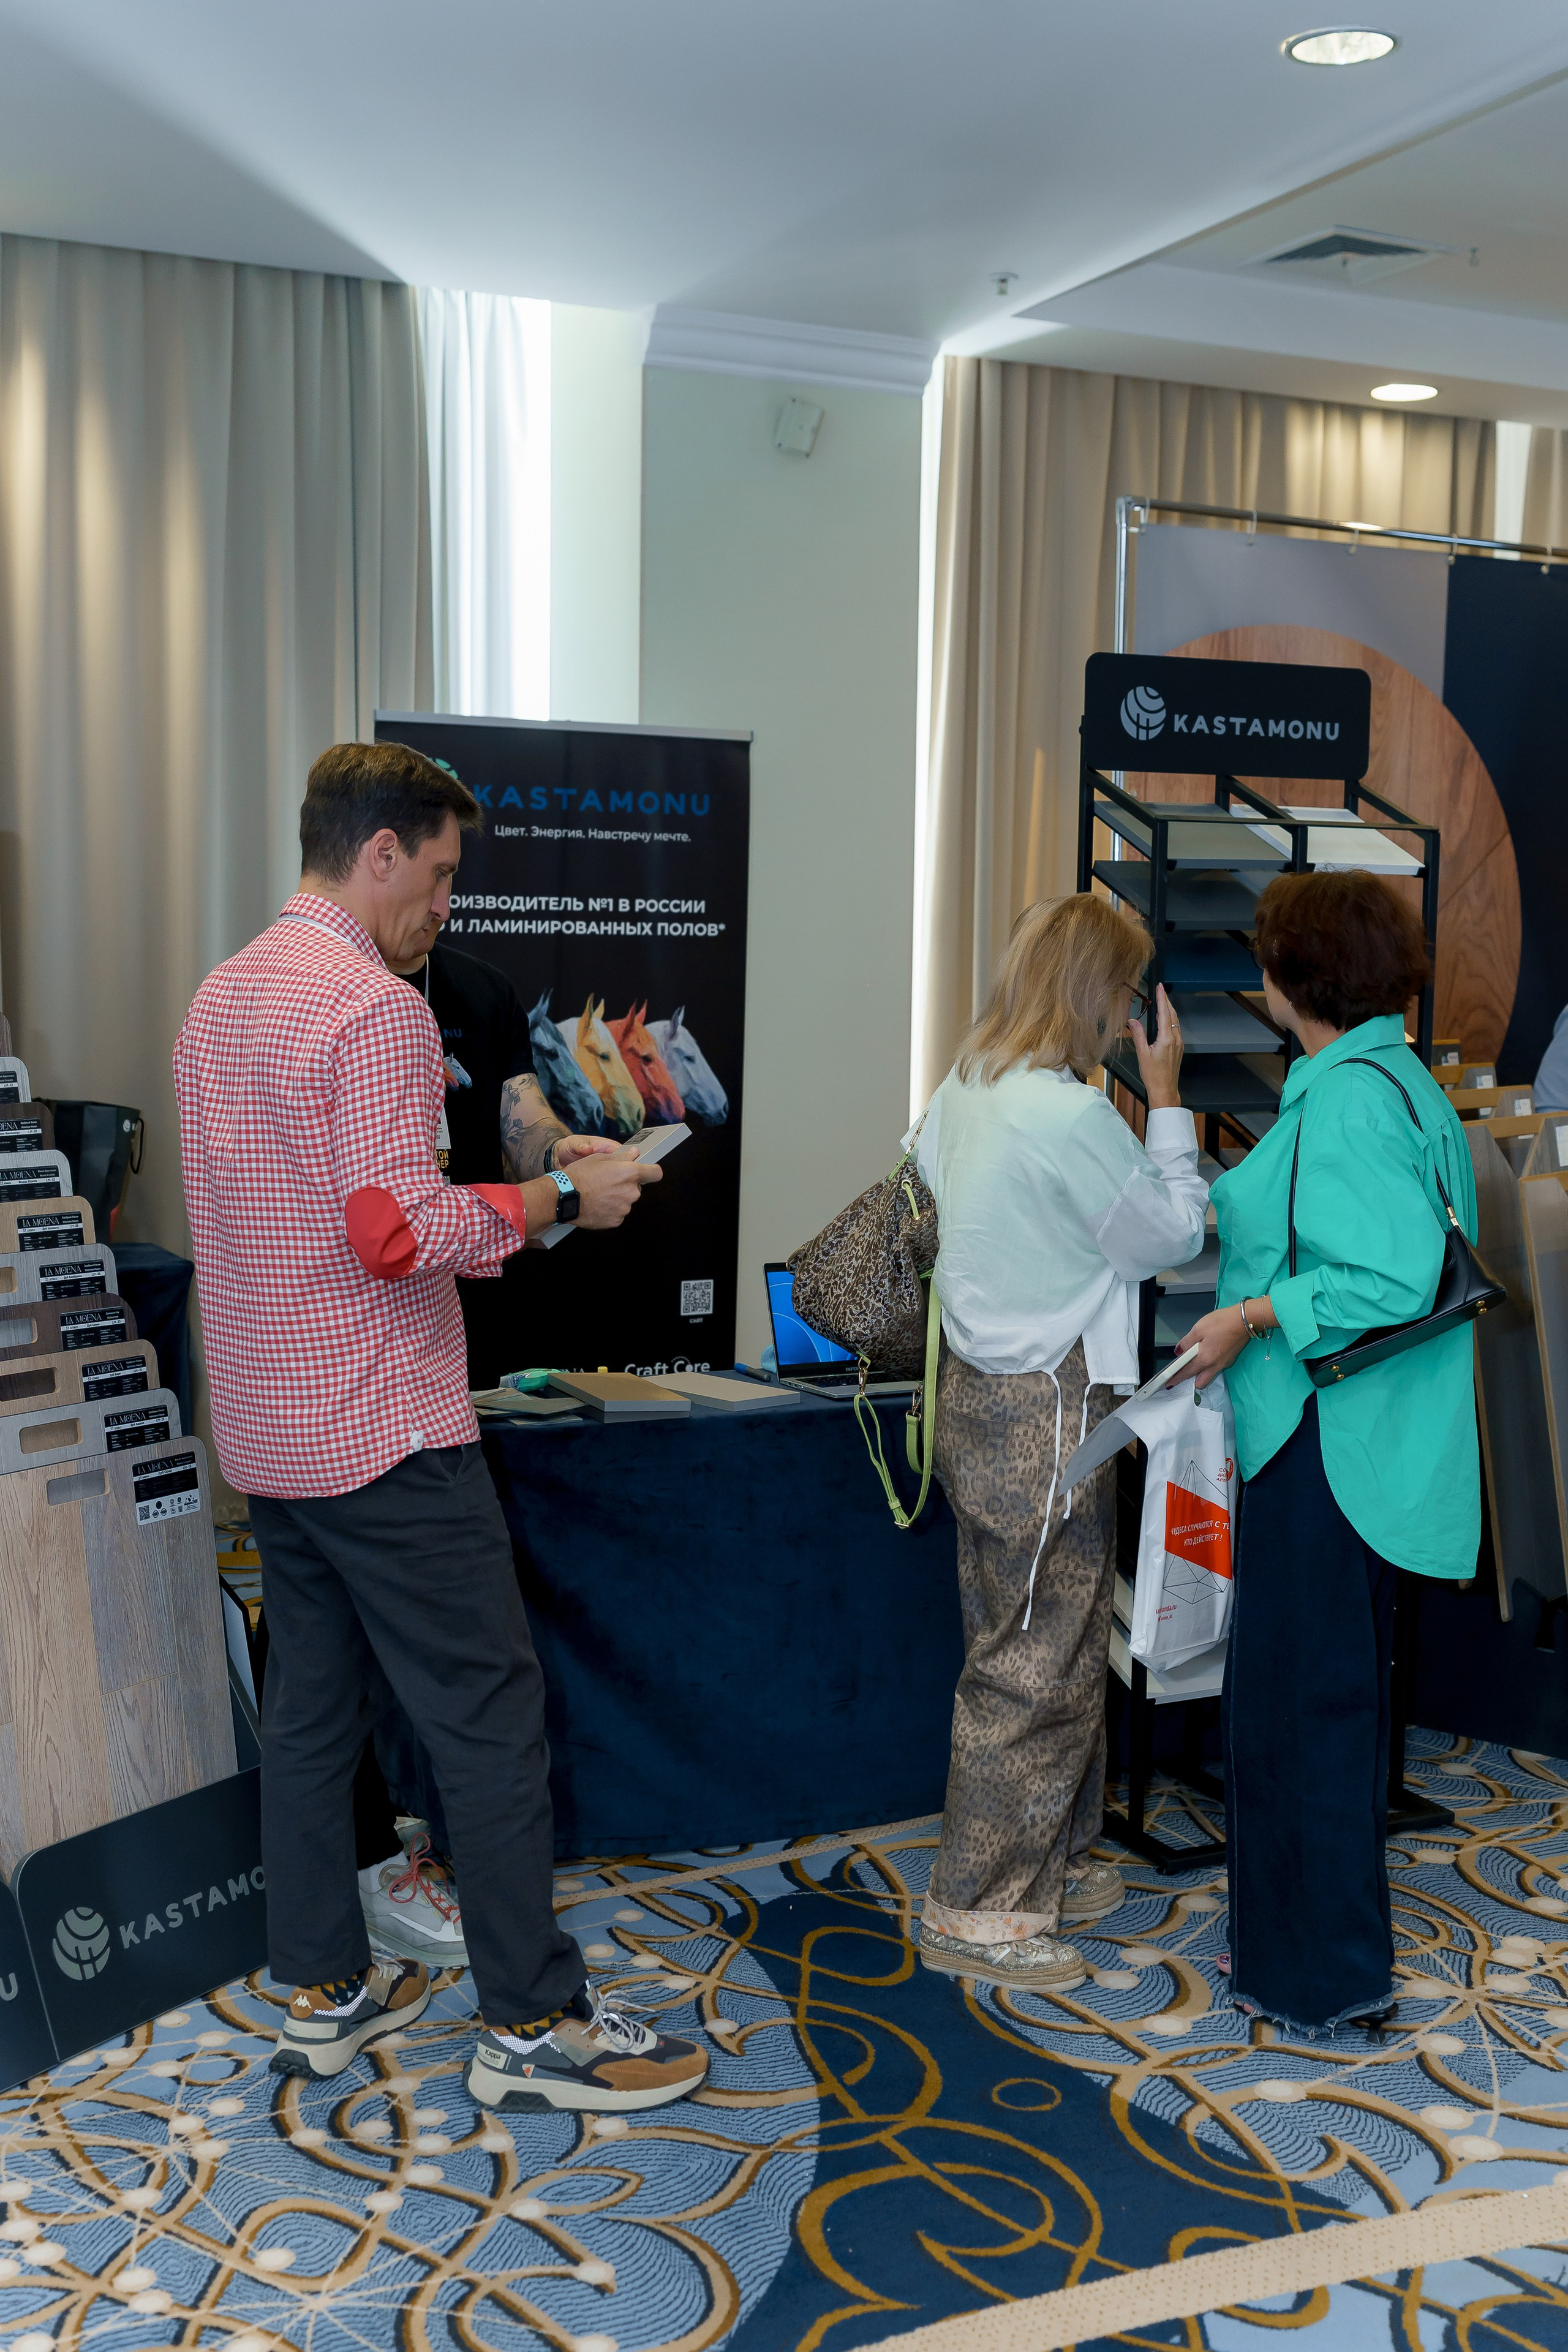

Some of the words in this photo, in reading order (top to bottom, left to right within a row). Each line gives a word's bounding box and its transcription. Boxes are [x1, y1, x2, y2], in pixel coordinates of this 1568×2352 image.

[1174, 714, 1340, 741] KASTAMONU
[473, 784, 710, 816] KASTAMONU
[494, 824, 529, 837] Цвет.
[530, 826, 586, 840] Энергия.
[588, 828, 652, 843] Навстречу
[654, 832, 692, 842] мечте.
[588, 897, 613, 911] №1
[619, 899, 630, 912] В
[635, 899, 706, 913] РОССИИ
[450, 918, 463, 933] И
[467, 919, 652, 936] ЛАМИНИРОВАННЫХ
[9, 1170, 37, 1179] MOENA
[23, 1219, 31, 1227] LA
[32, 1216, 59, 1226] MOENA
[55, 1265, 81, 1275] MOENA
[66, 1316, 74, 1325] LA
[75, 1313, 102, 1323] MOENA
[97, 1362, 124, 1373] MOENA
[625, 1362, 669, 1376] Craft
[673, 1360, 710, 1373] Core
[110, 1417, 118, 1425] LA
[119, 1412, 146, 1423] MOENA
[138, 1466, 146, 1474] LA
[148, 1460, 174, 1472] MOENA
[1171, 1525, 1187, 1536] ЧУДЕСА
[1188, 1520, 1213, 1532] СЛУЧАЮТСЯ
[1184, 1538, 1193, 1547] КТО
[119, 1866, 266, 1949] KASTAMO
[484, 2048, 501, 2060] Kappa
